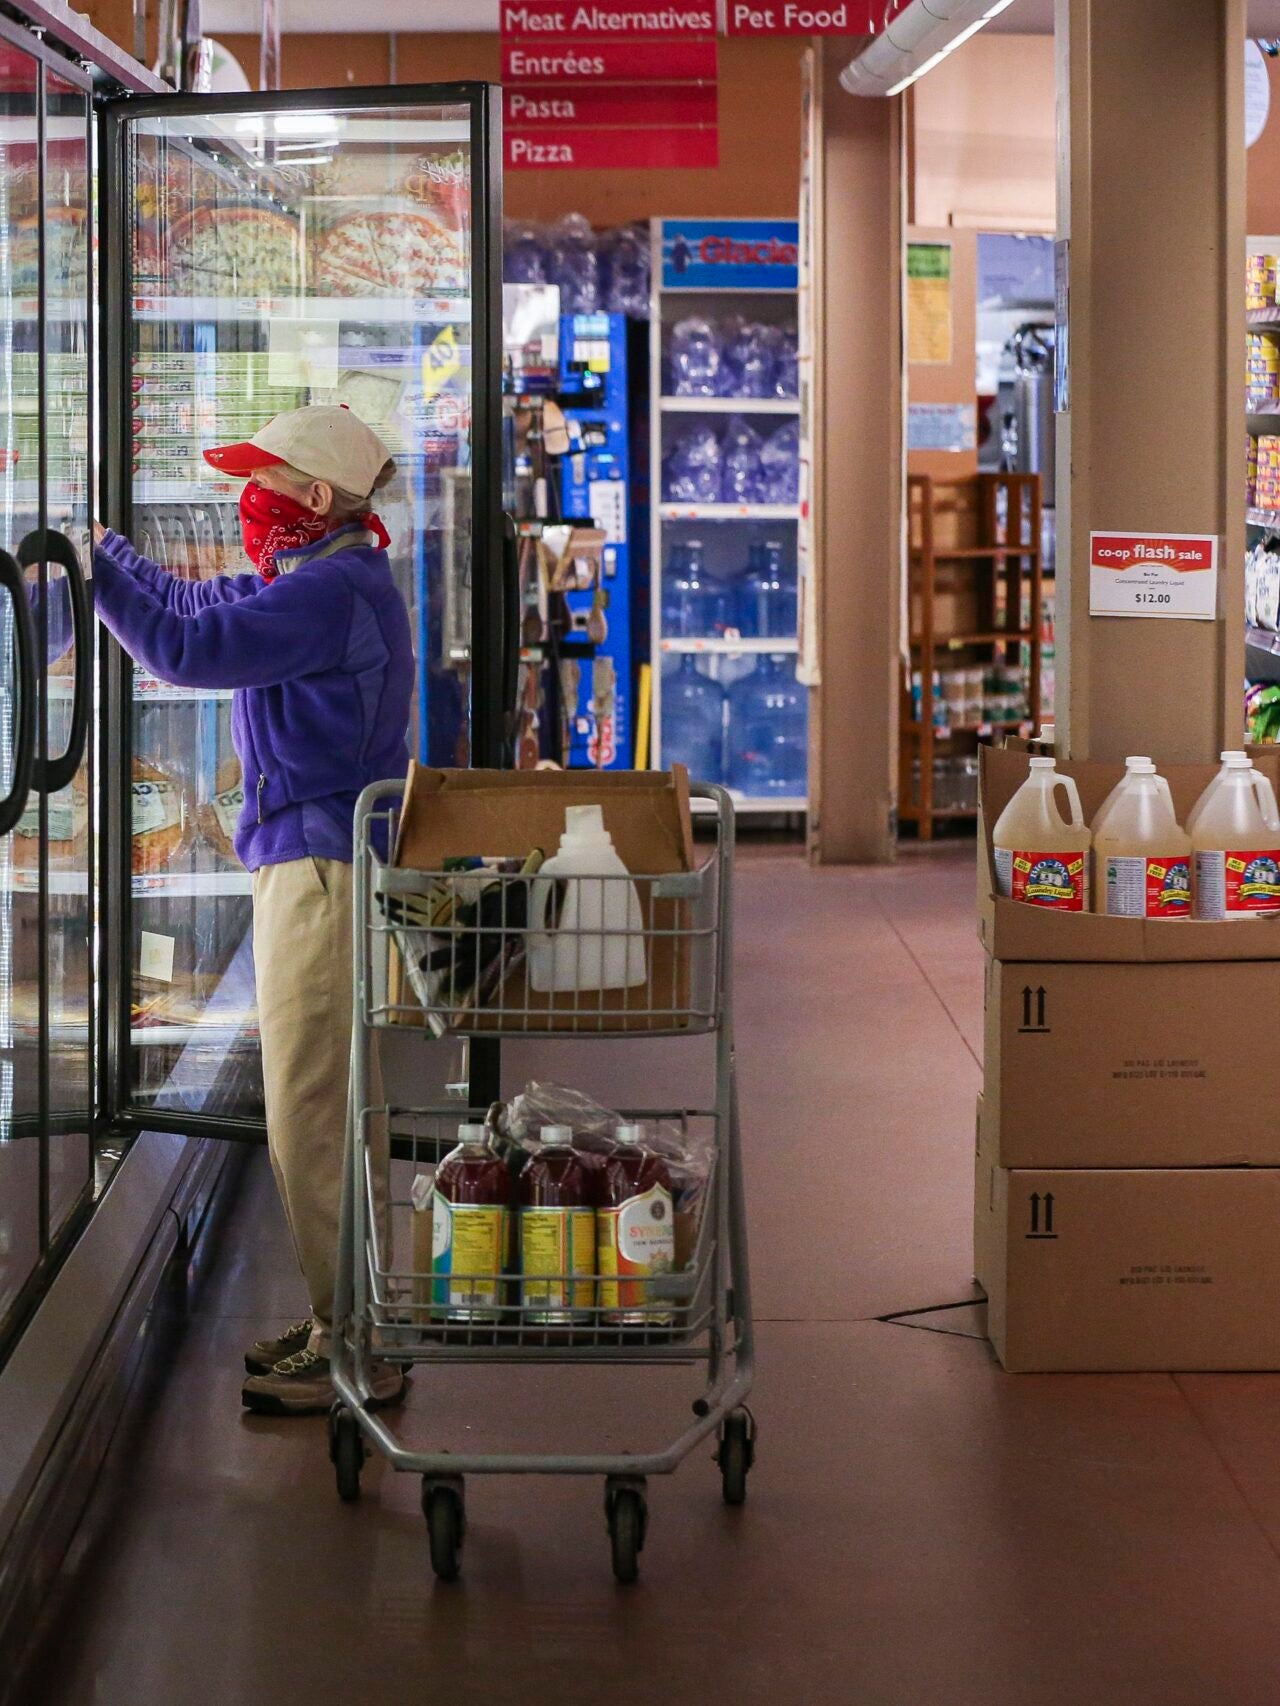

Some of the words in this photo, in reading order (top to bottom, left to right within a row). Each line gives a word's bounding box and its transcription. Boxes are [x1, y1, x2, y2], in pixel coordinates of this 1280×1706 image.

[505, 8, 566, 31] Meat
[570, 7, 712, 30] Alternatives
[734, 5, 775, 29] Pet
[784, 4, 848, 28] Food
[509, 50, 605, 75] Entrées
[510, 95, 576, 119] Pasta
[510, 139, 574, 163] Pizza
[1097, 548, 1131, 560] co-op
[1132, 544, 1176, 559] flash
[1178, 550, 1203, 560] sale
[1135, 593, 1171, 604] $12.00
